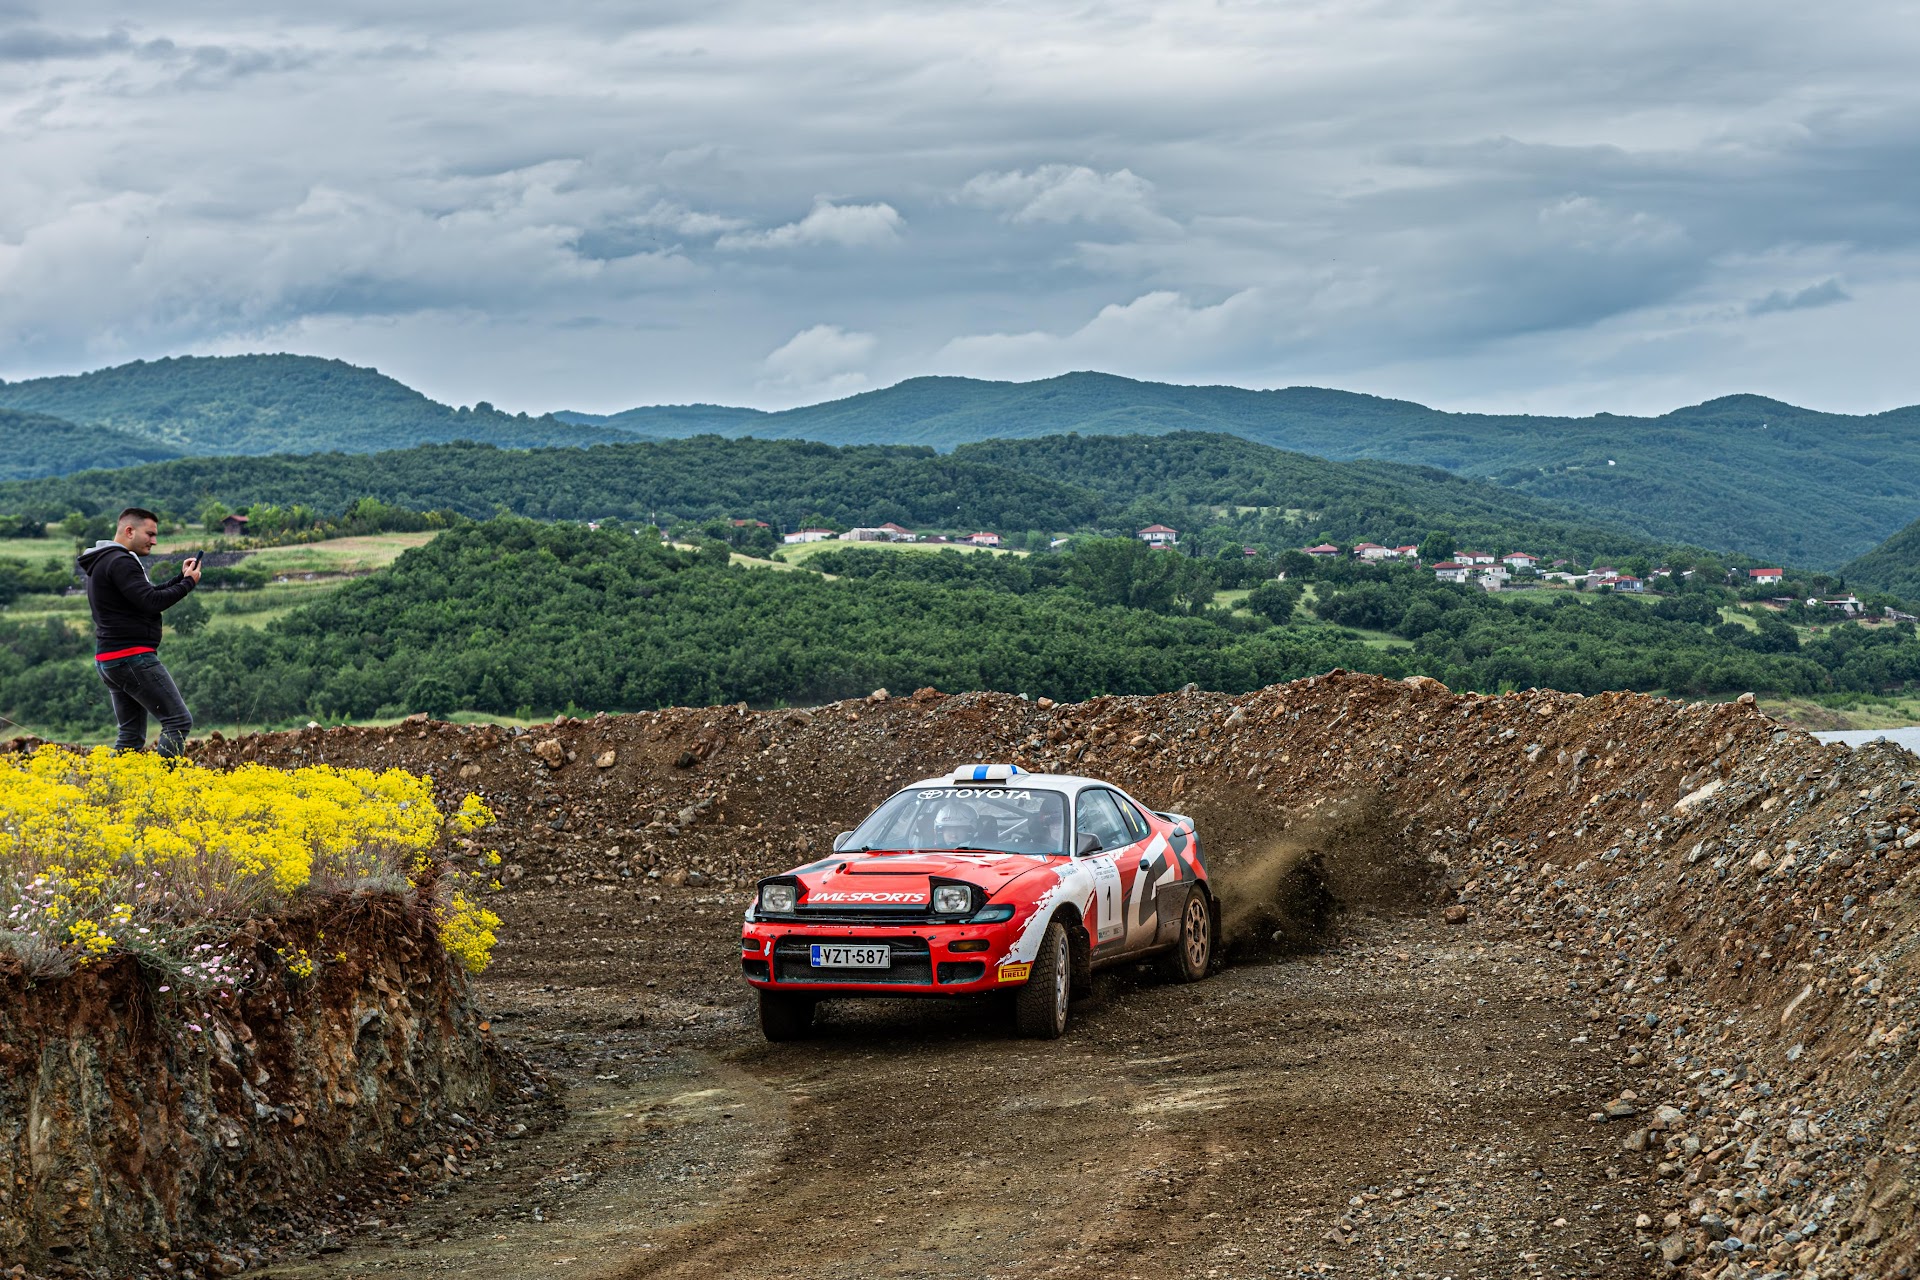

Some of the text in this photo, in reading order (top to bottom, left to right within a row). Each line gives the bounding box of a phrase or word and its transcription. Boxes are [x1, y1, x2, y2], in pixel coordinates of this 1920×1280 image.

[944, 788, 1031, 800] TOYOTA
[806, 892, 926, 902] JML-SPORTS
[1106, 885, 1112, 921] 1
[1000, 967, 1027, 979] PIRELLI
